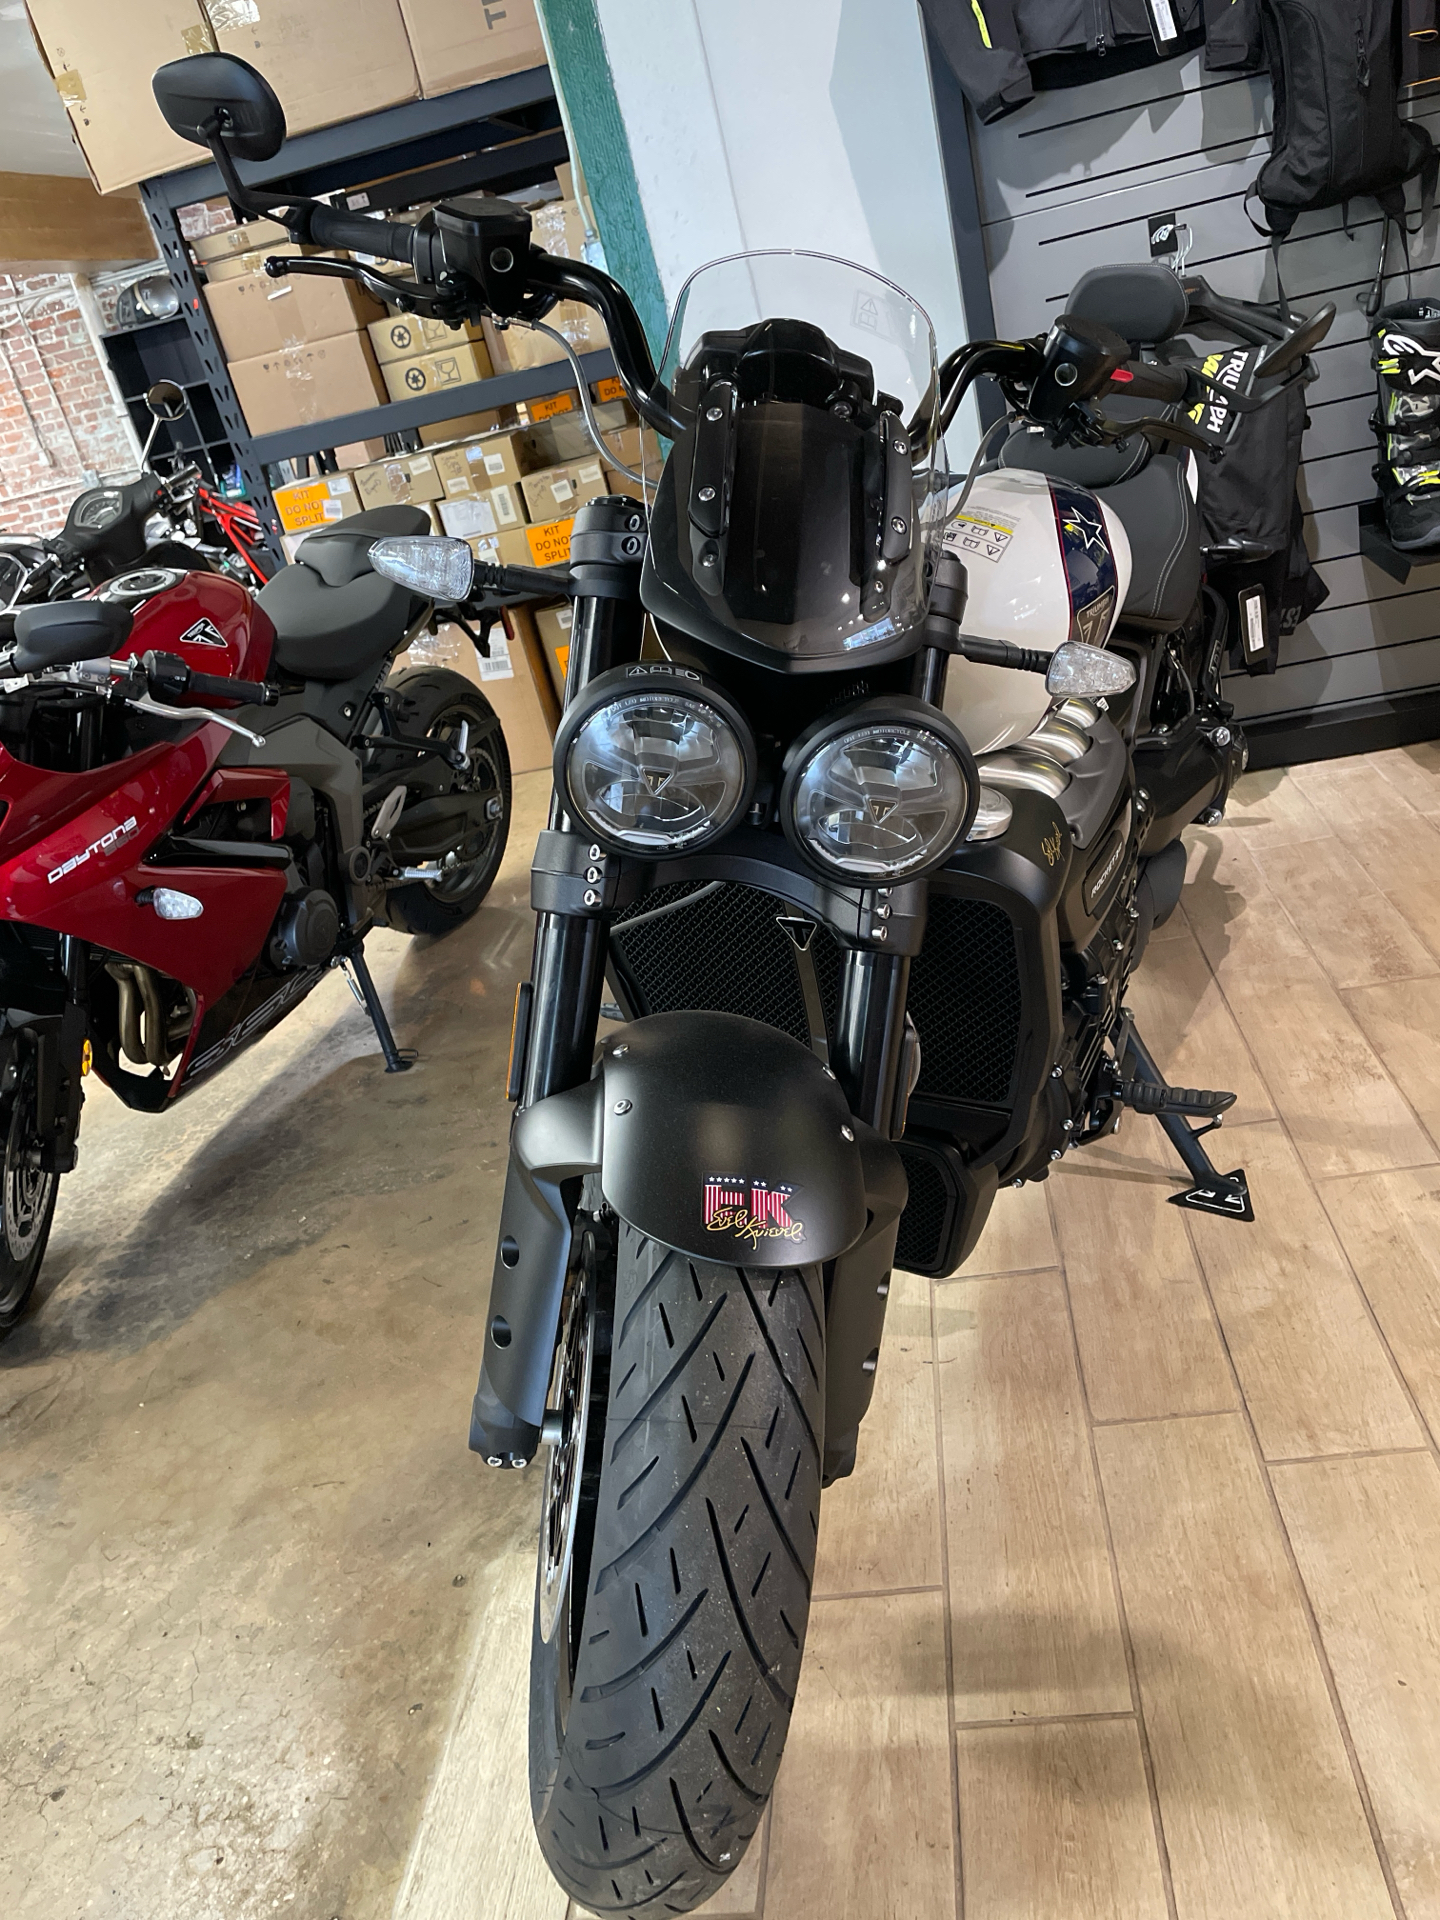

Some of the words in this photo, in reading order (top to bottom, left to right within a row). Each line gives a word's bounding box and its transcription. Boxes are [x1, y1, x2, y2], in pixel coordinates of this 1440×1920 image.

[544, 401, 557, 411] KIT
[293, 490, 309, 501] KIT
[285, 504, 301, 516] DO
[304, 499, 323, 512] NO
[294, 512, 324, 526] SPLIT
[543, 525, 559, 536] KIT
[535, 540, 551, 551] DO
[553, 535, 571, 547] NO
